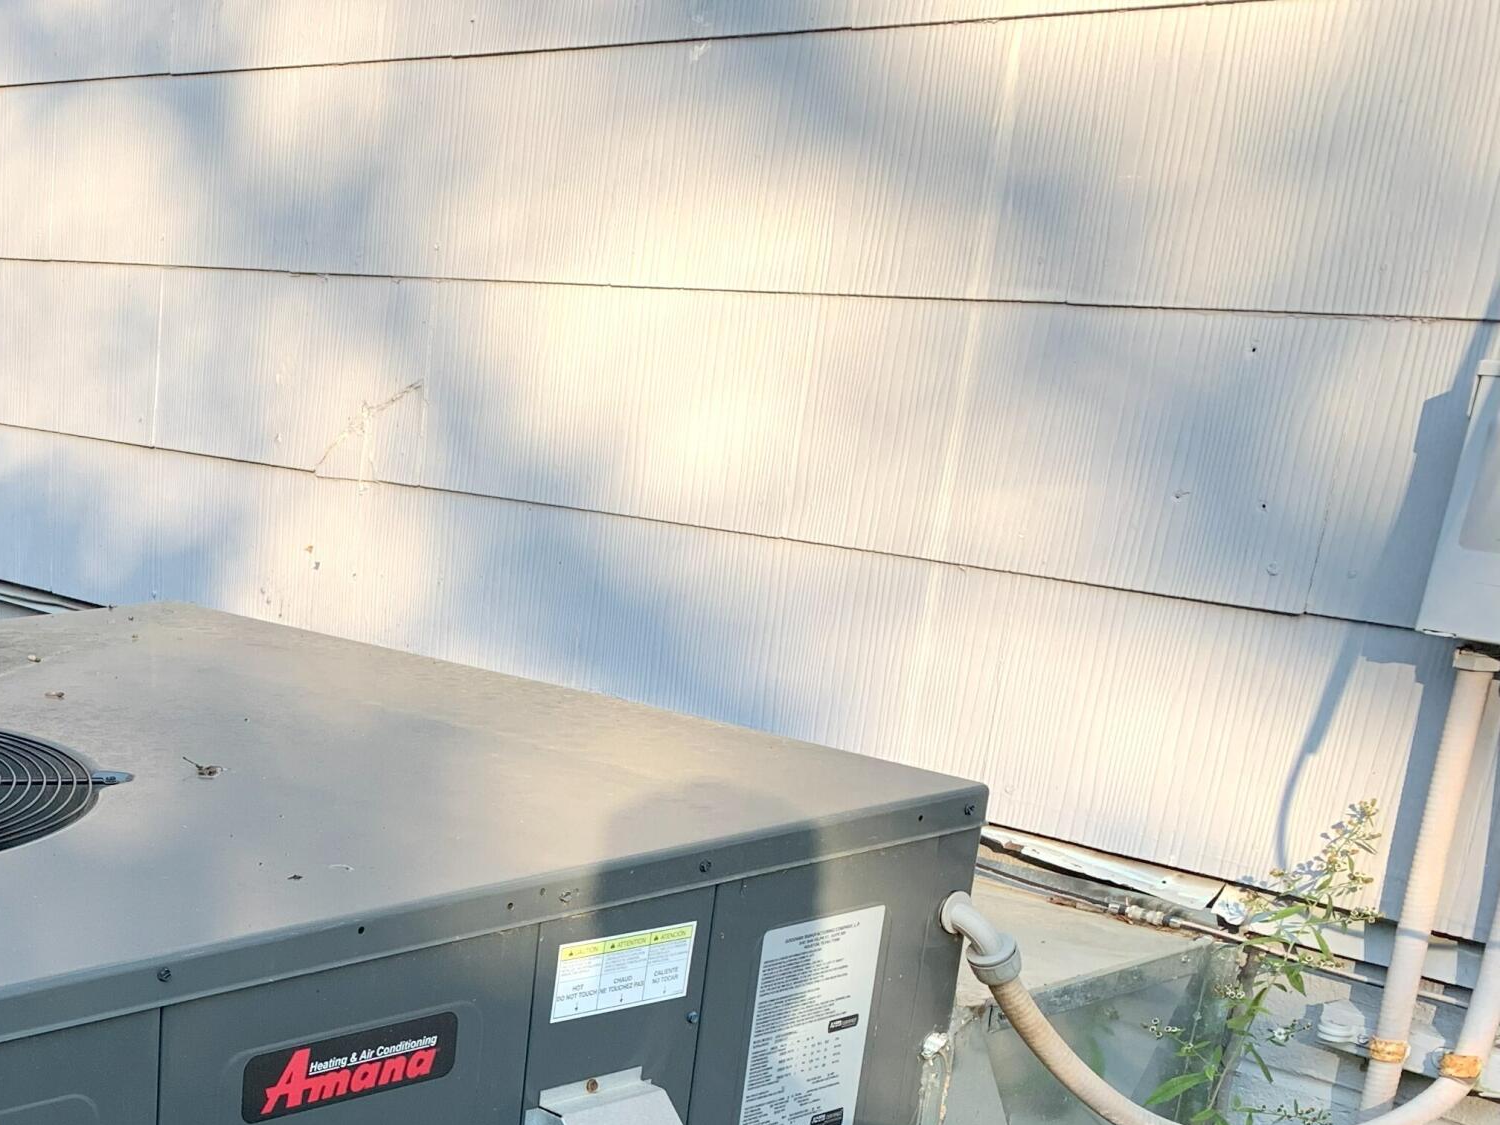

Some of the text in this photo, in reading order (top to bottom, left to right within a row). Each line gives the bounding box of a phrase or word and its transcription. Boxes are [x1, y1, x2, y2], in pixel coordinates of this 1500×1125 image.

[617, 938, 646, 947] ATTENTION
[653, 966, 679, 976] CALIENTE
[613, 974, 633, 984] CHAUD
[310, 1035, 437, 1073] Heating & Air Conditioning
[260, 1047, 437, 1114] Amana
